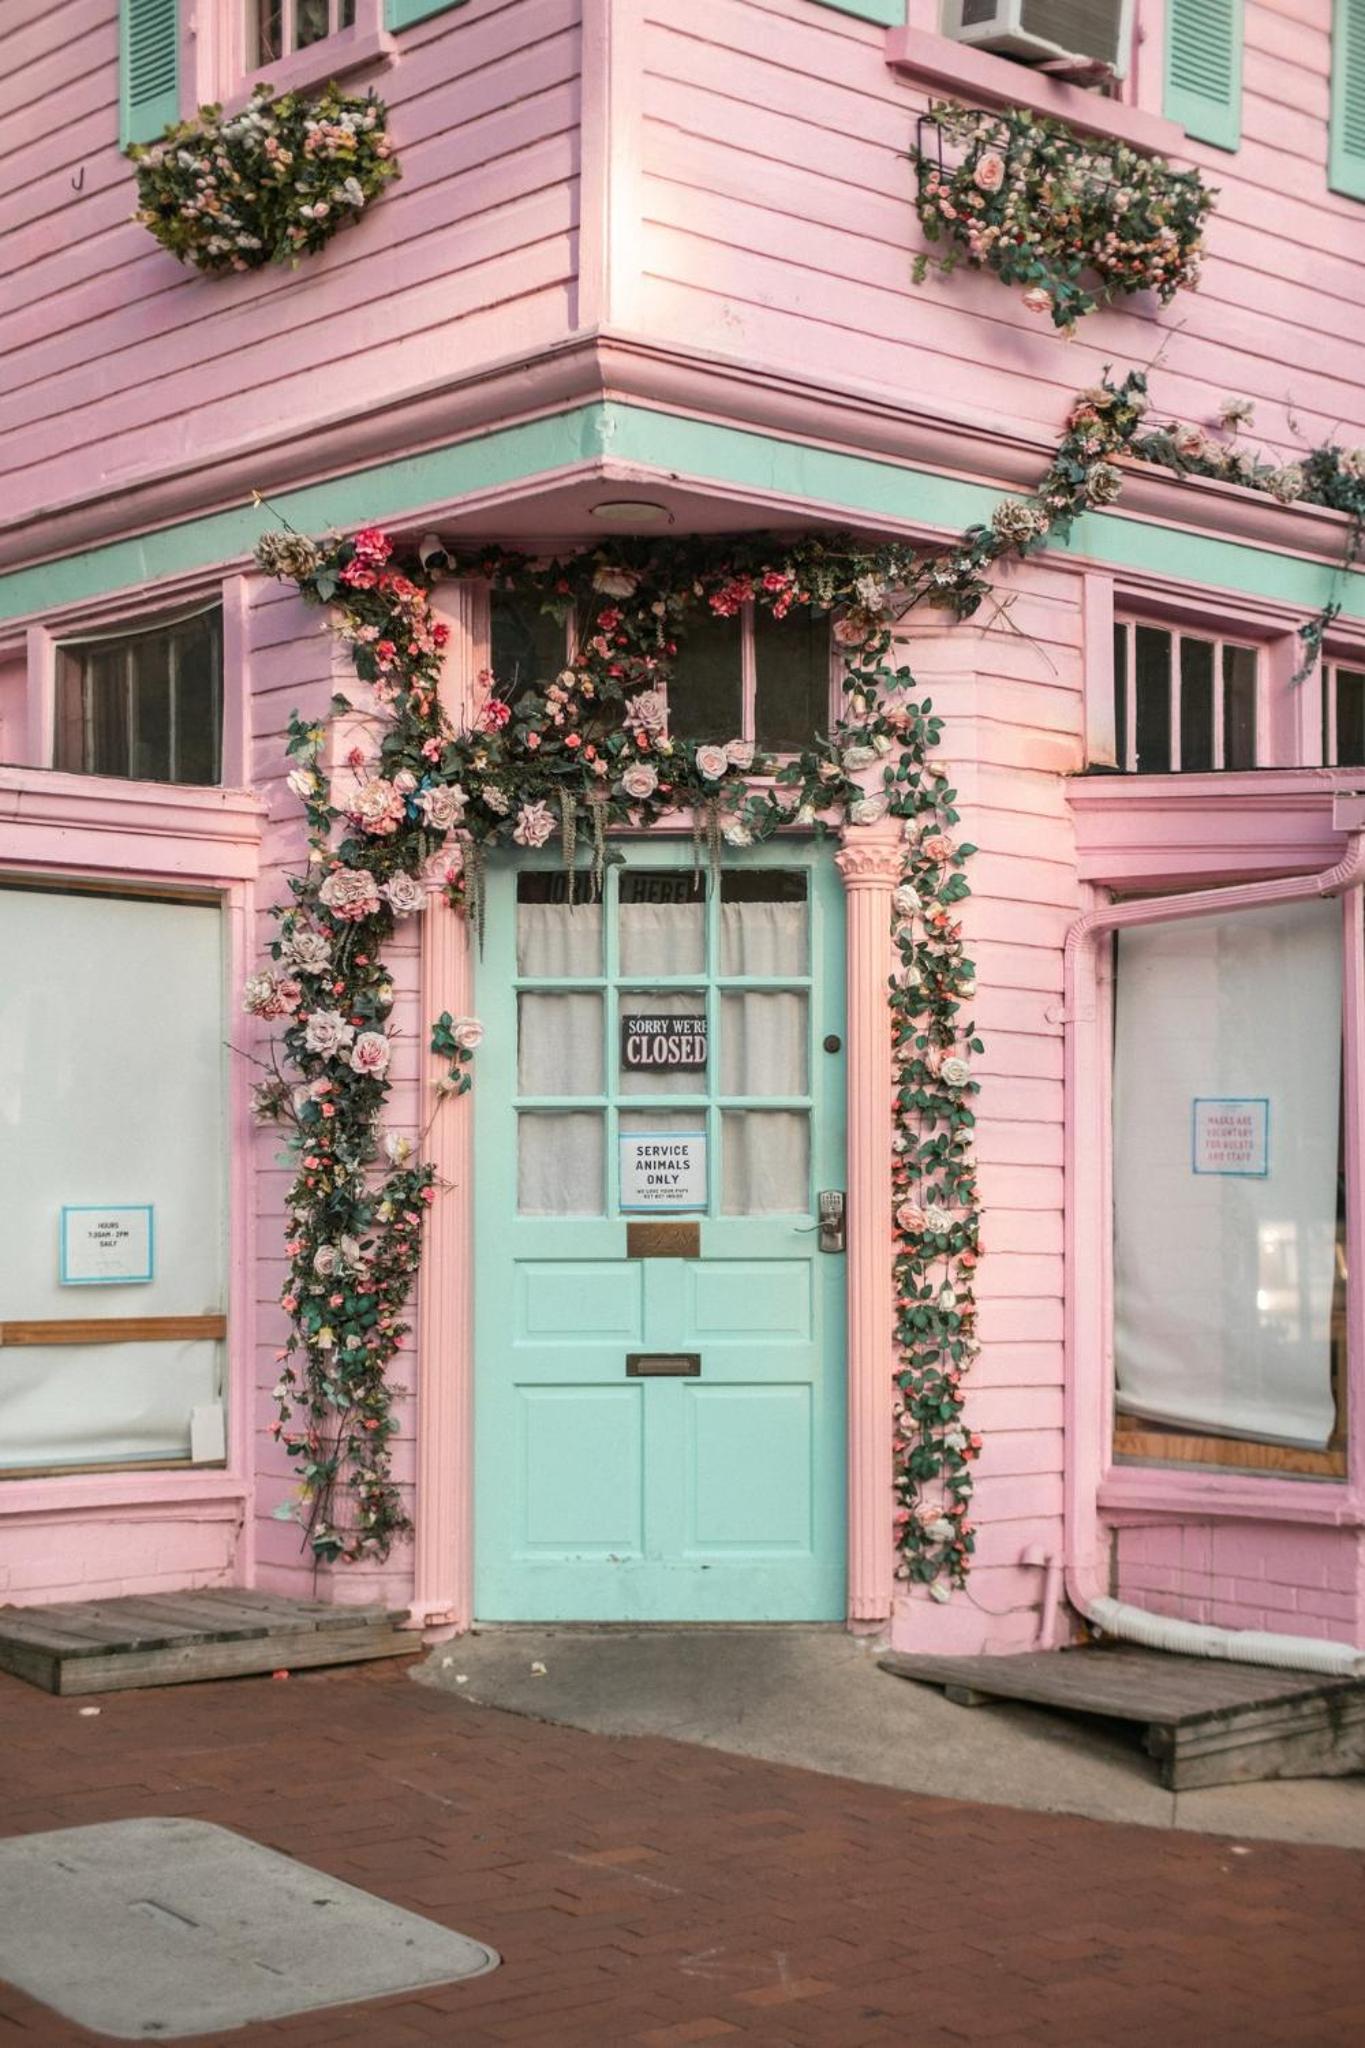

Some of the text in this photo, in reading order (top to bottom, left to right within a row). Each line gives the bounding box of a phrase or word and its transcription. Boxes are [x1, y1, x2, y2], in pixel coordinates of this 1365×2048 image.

[628, 1020, 670, 1034] SORRY
[627, 1035, 707, 1064] CLOSED
[636, 1145, 689, 1156] SERVICE
[635, 1160, 691, 1170] ANIMALS
[647, 1174, 679, 1185] ONLY
